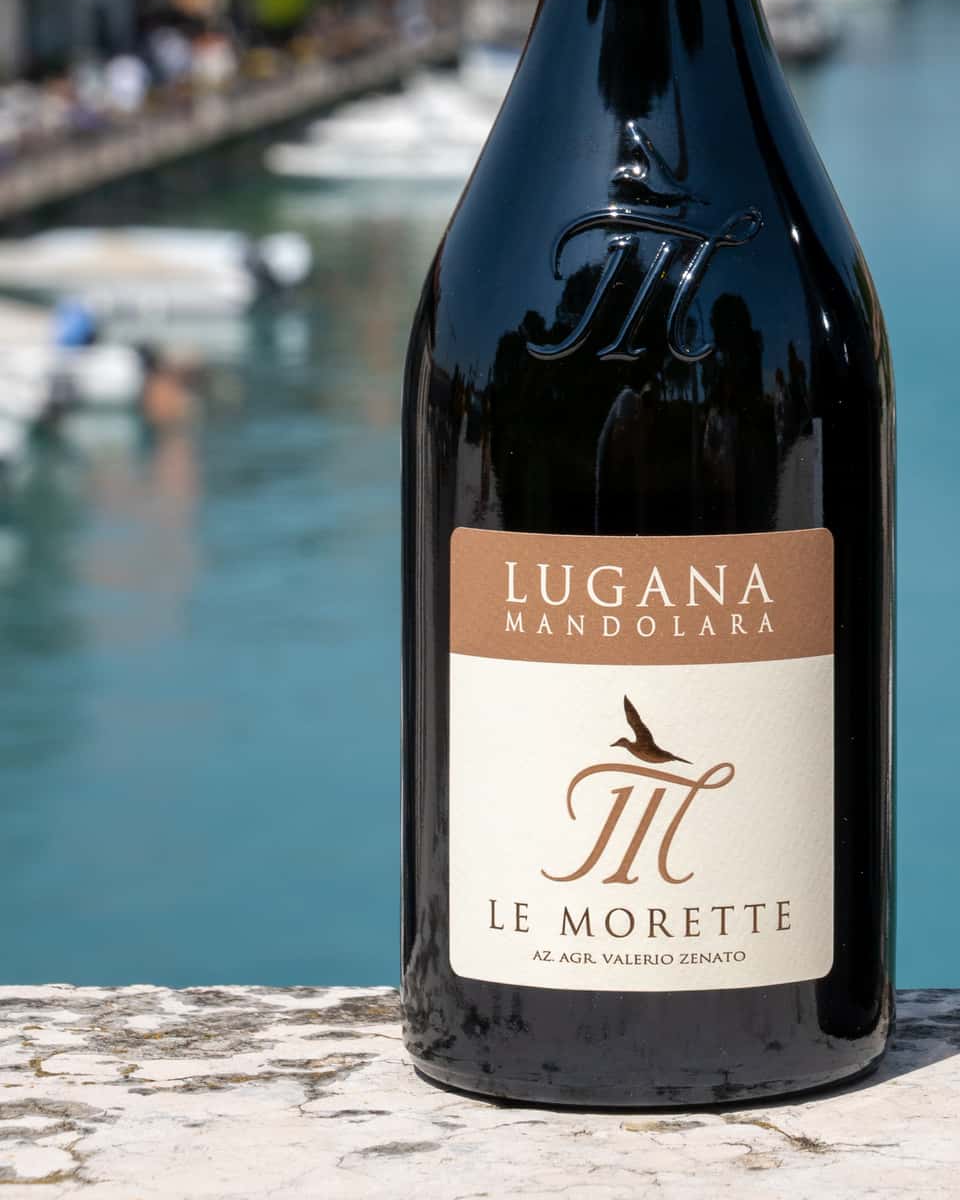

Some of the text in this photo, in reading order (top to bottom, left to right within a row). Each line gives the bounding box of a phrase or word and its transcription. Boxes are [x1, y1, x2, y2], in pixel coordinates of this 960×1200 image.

[505, 561, 775, 607] LUGANA
[505, 611, 774, 637] MANDOLARA
[488, 899, 792, 938] LE MORETTE
[602, 953, 674, 966] VALERIO
[679, 950, 747, 965] ZENATO
